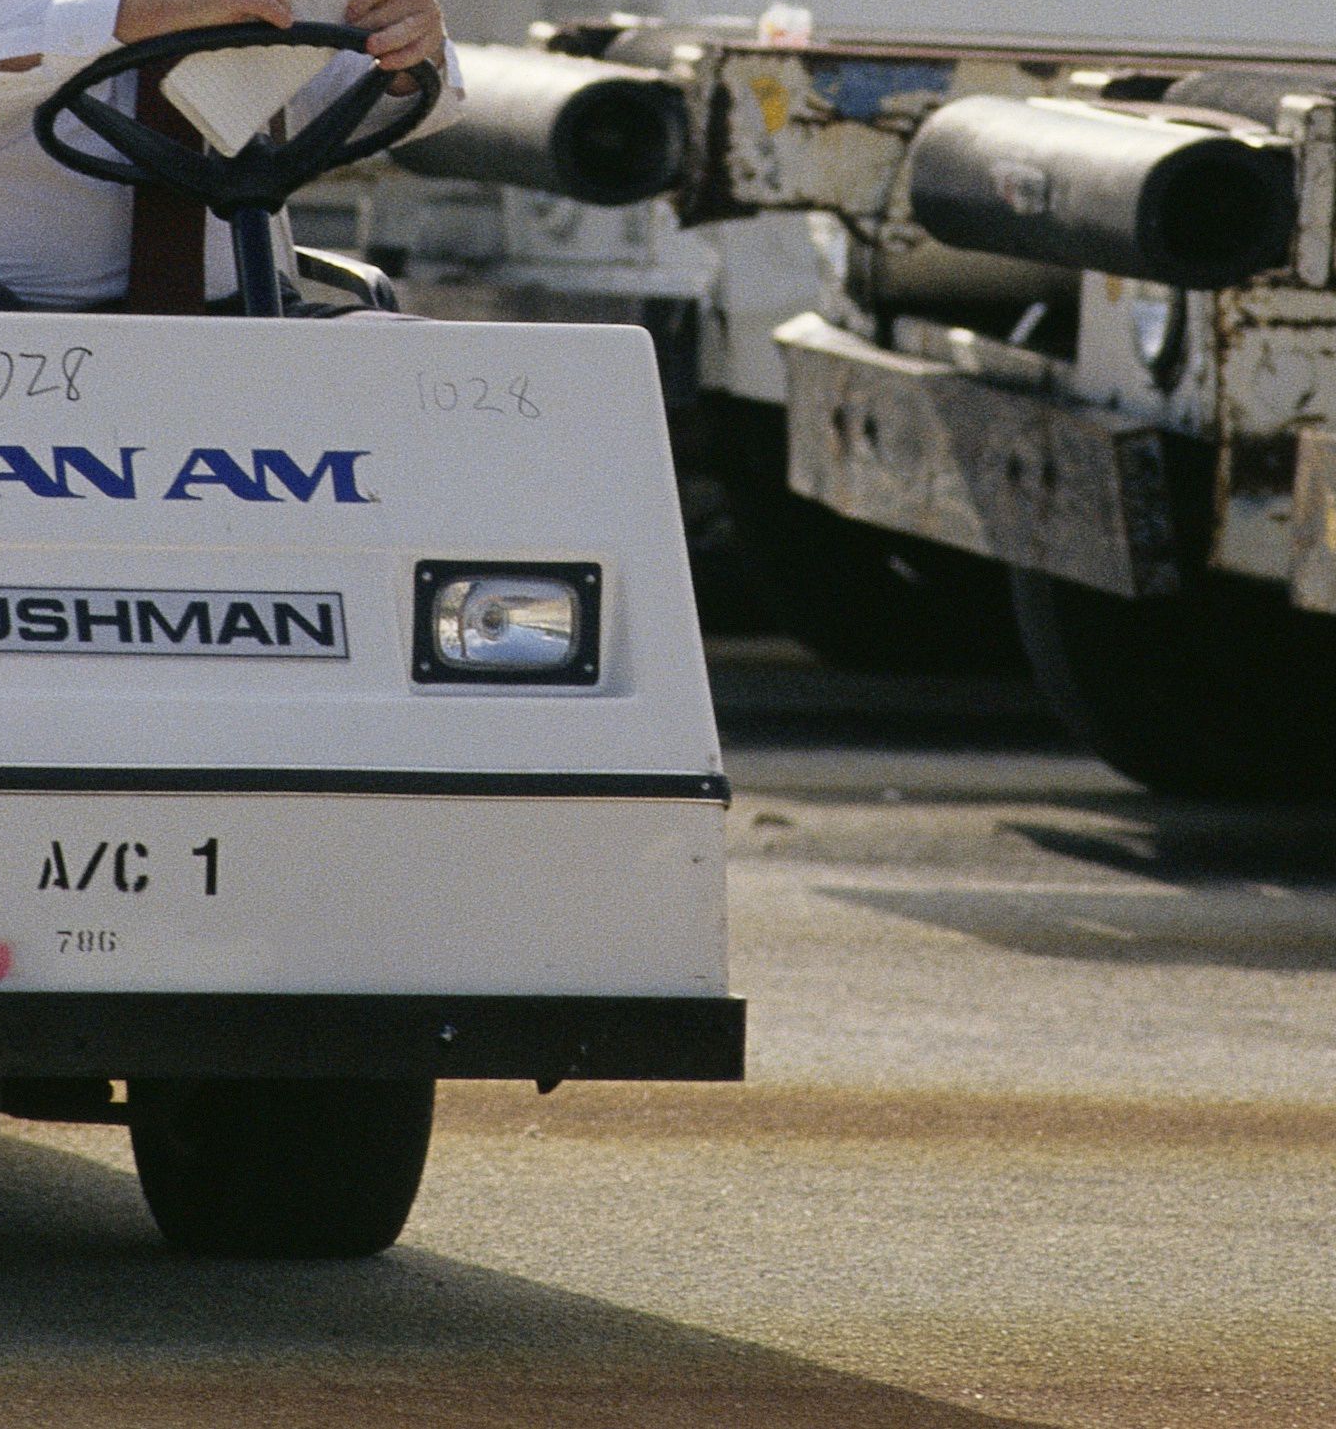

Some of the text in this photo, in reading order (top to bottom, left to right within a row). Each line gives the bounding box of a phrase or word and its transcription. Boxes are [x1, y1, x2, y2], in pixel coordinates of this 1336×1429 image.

[415, 371, 541, 419] 1028
[163, 447, 373, 504] AM
[37, 836, 219, 896] A/C 1
[56, 929, 117, 954] 786
